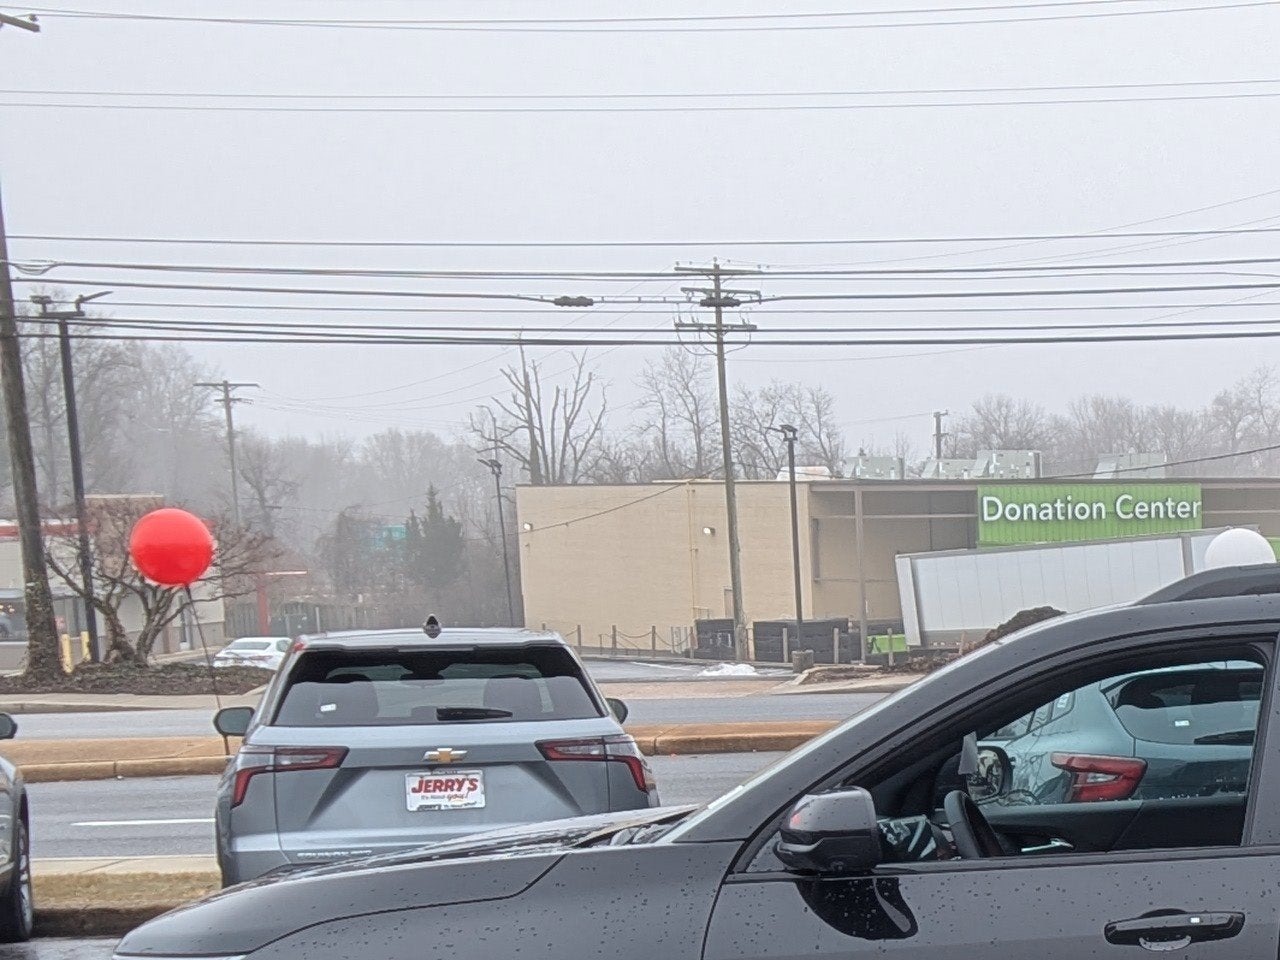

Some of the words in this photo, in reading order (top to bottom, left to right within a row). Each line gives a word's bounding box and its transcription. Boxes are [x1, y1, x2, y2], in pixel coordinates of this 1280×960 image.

[982, 495, 1106, 521] Donation
[1115, 494, 1202, 519] Center
[411, 777, 479, 793] JERRY'S
